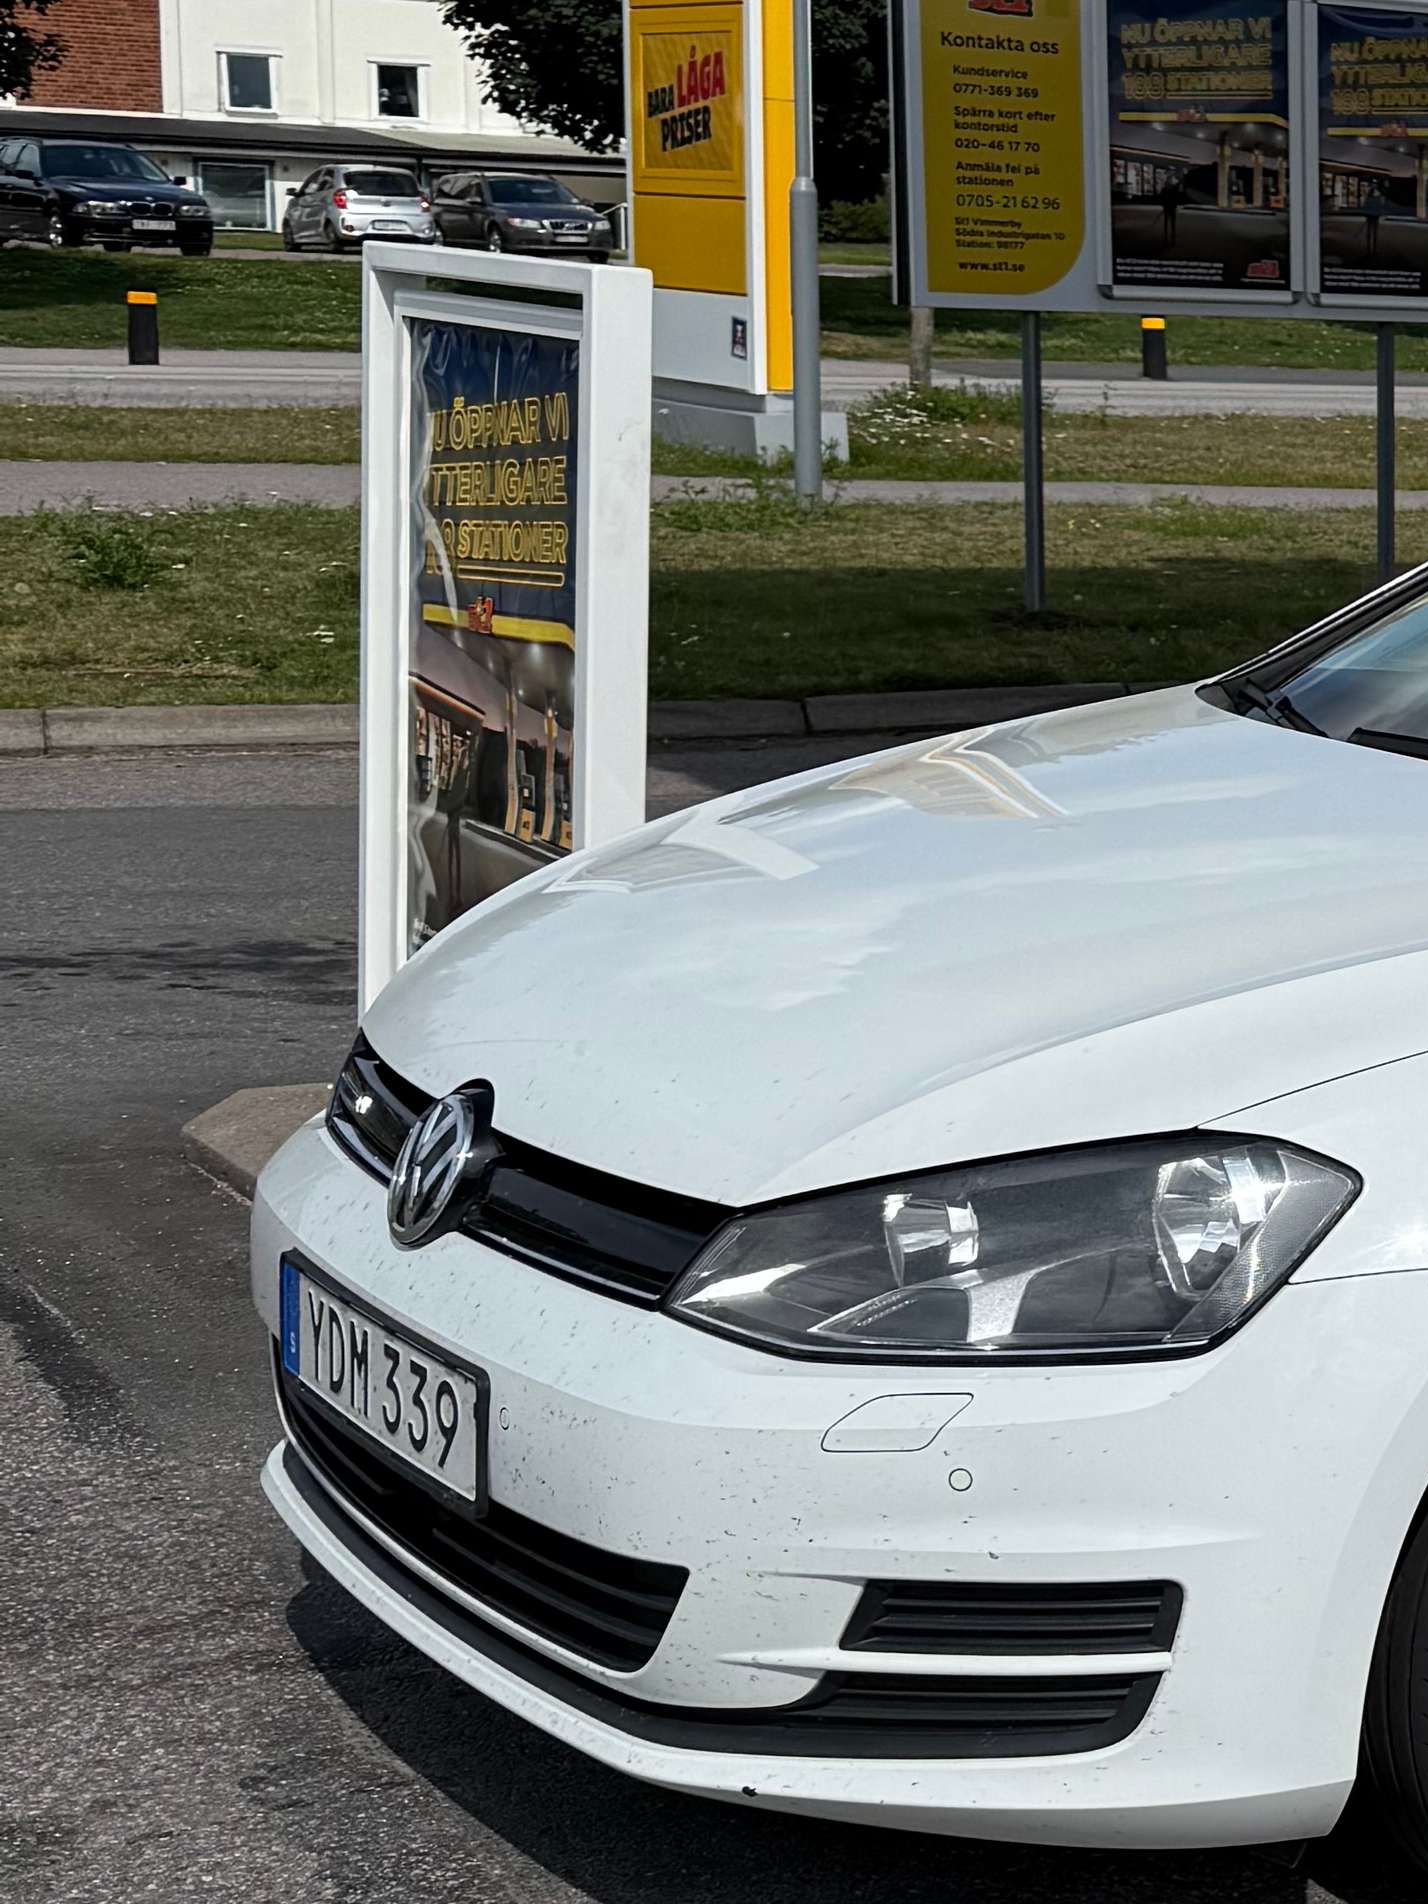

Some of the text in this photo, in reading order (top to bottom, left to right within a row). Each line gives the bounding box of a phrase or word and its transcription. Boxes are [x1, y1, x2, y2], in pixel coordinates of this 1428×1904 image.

[1120, 16, 1273, 44] NU ÖPPNAR VI
[940, 31, 1060, 54] Kontakta oss
[1330, 42, 1360, 61] NU
[1121, 43, 1273, 69] YTTERLIGARE
[677, 45, 726, 108] LÅGA
[953, 65, 1028, 80] Kundservice
[953, 83, 1039, 98] 0771-369 369
[954, 105, 1056, 122] Spärra kort efter
[661, 105, 712, 152] PRISER
[954, 119, 1019, 133] kontorstid
[1008, 141, 1021, 151] 17
[1024, 142, 1040, 152] 70
[956, 161, 1002, 173] Anmäla
[1024, 163, 1041, 176] på
[956, 175, 1014, 187] stationen
[449, 396, 541, 451] ÖPPNAR
[544, 392, 570, 443] VI
[423, 455, 569, 507] TTERLIGARE
[457, 520, 569, 564] STATIONER
[308, 1287, 459, 1470] YDM 339
